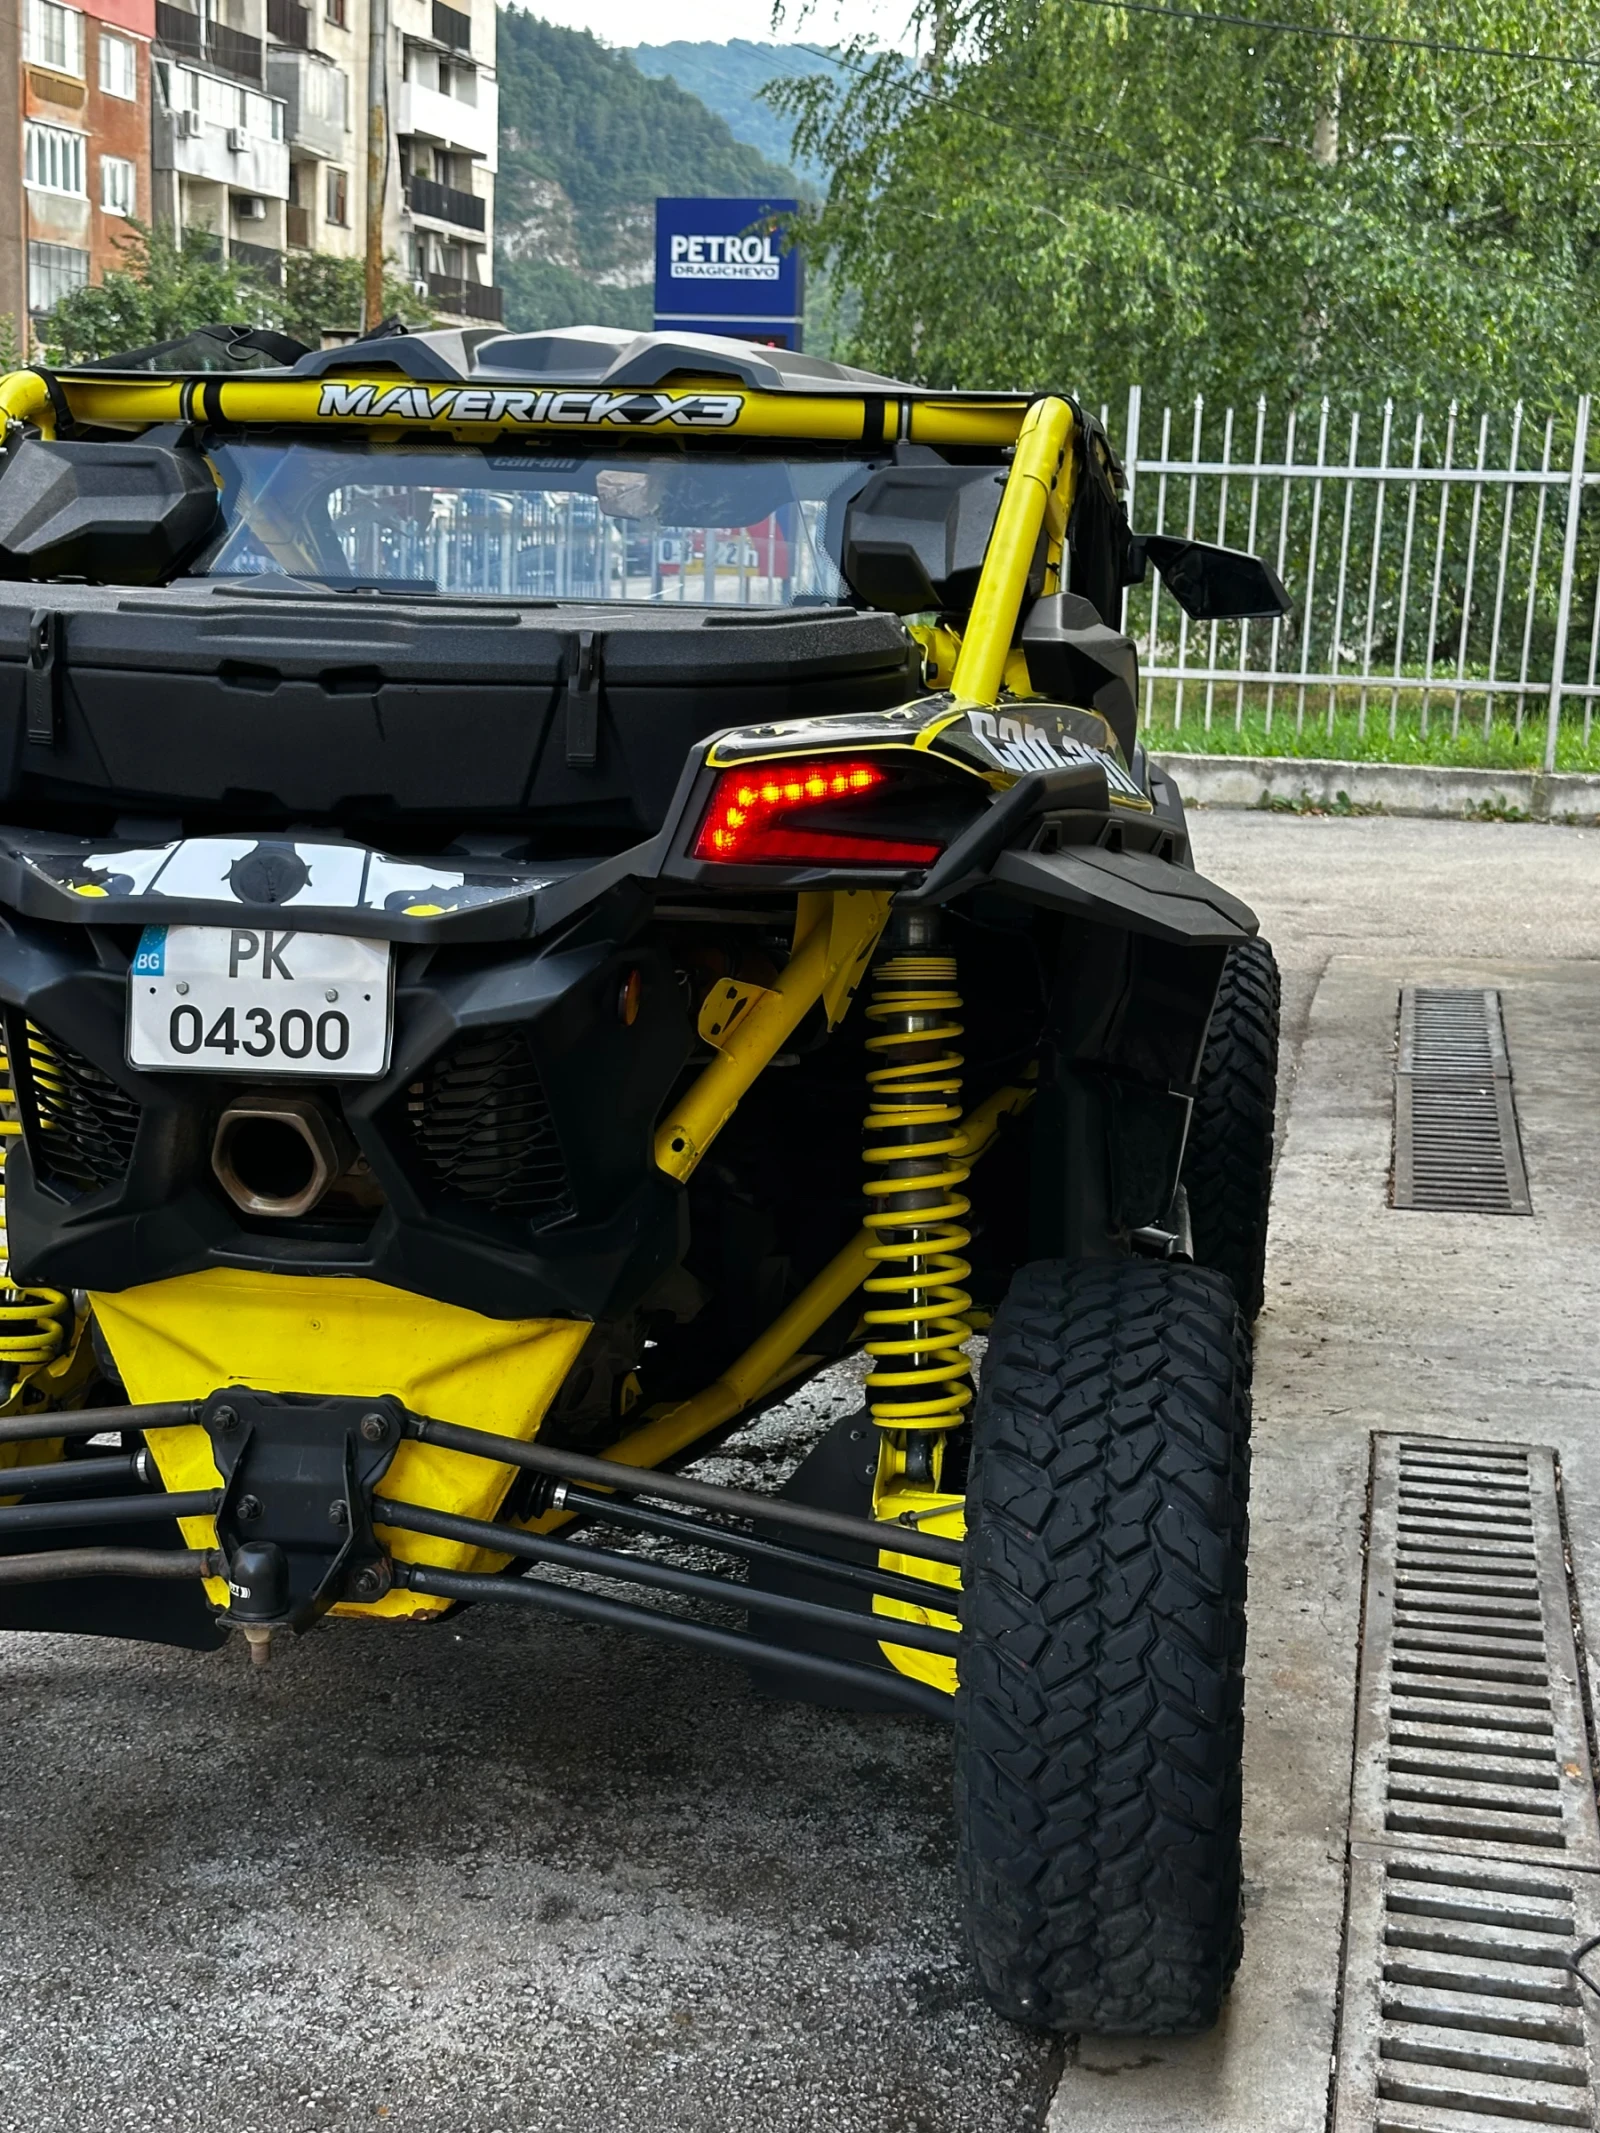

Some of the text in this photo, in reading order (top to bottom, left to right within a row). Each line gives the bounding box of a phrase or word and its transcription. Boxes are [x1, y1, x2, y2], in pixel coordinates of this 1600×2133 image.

[670, 234, 780, 264] PETROL
[674, 265, 776, 278] DRAGICHEVO
[318, 384, 745, 426] MAVERICK X3
[137, 953, 160, 970] BG
[228, 929, 298, 980] PK
[169, 1004, 350, 1060] 04300
